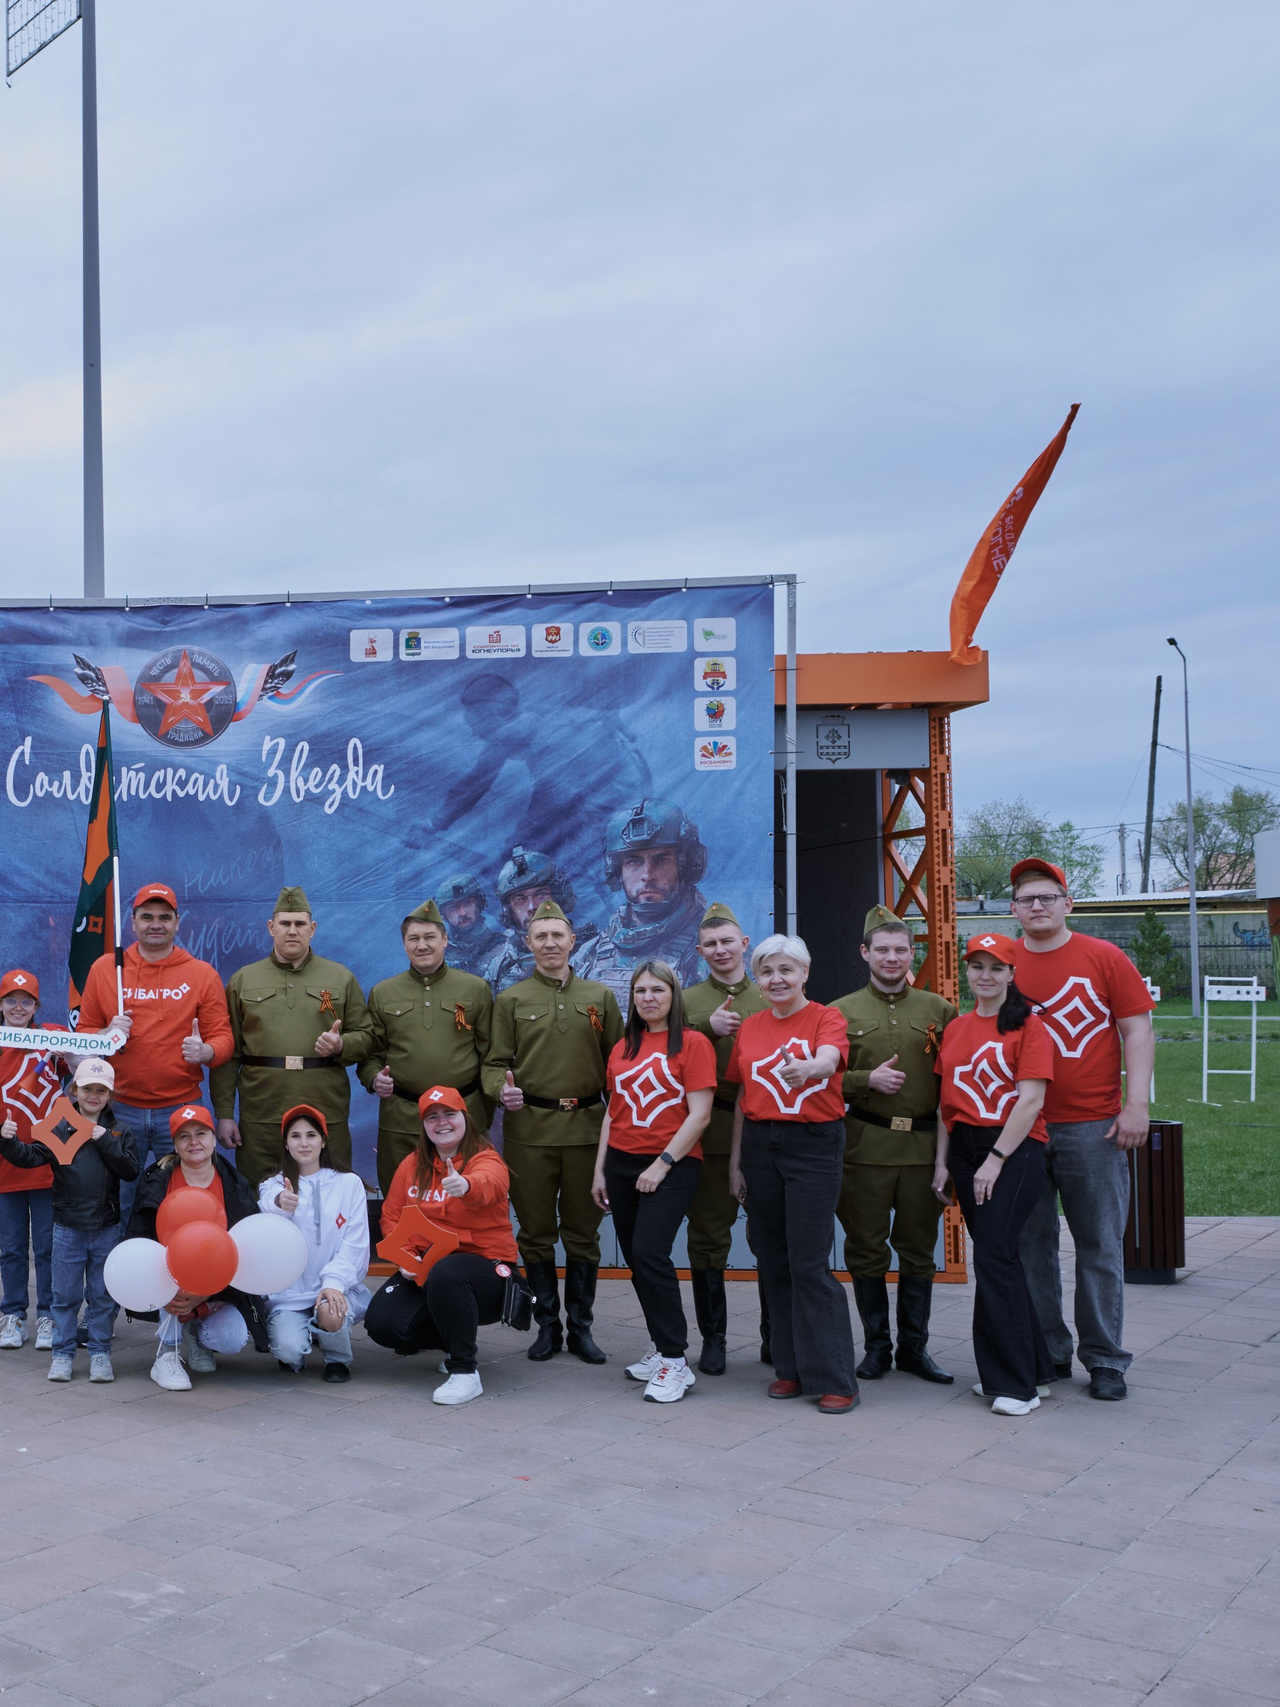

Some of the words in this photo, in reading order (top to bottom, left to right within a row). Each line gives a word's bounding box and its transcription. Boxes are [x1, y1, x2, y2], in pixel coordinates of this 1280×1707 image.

[149, 657, 172, 676] ЧЕСТЬ
[192, 654, 221, 677] ПАМЯТЬ
[167, 730, 204, 743] ТРАДИЦИИ
[5, 736, 241, 808] Солдтская
[259, 735, 395, 815] Звезда
